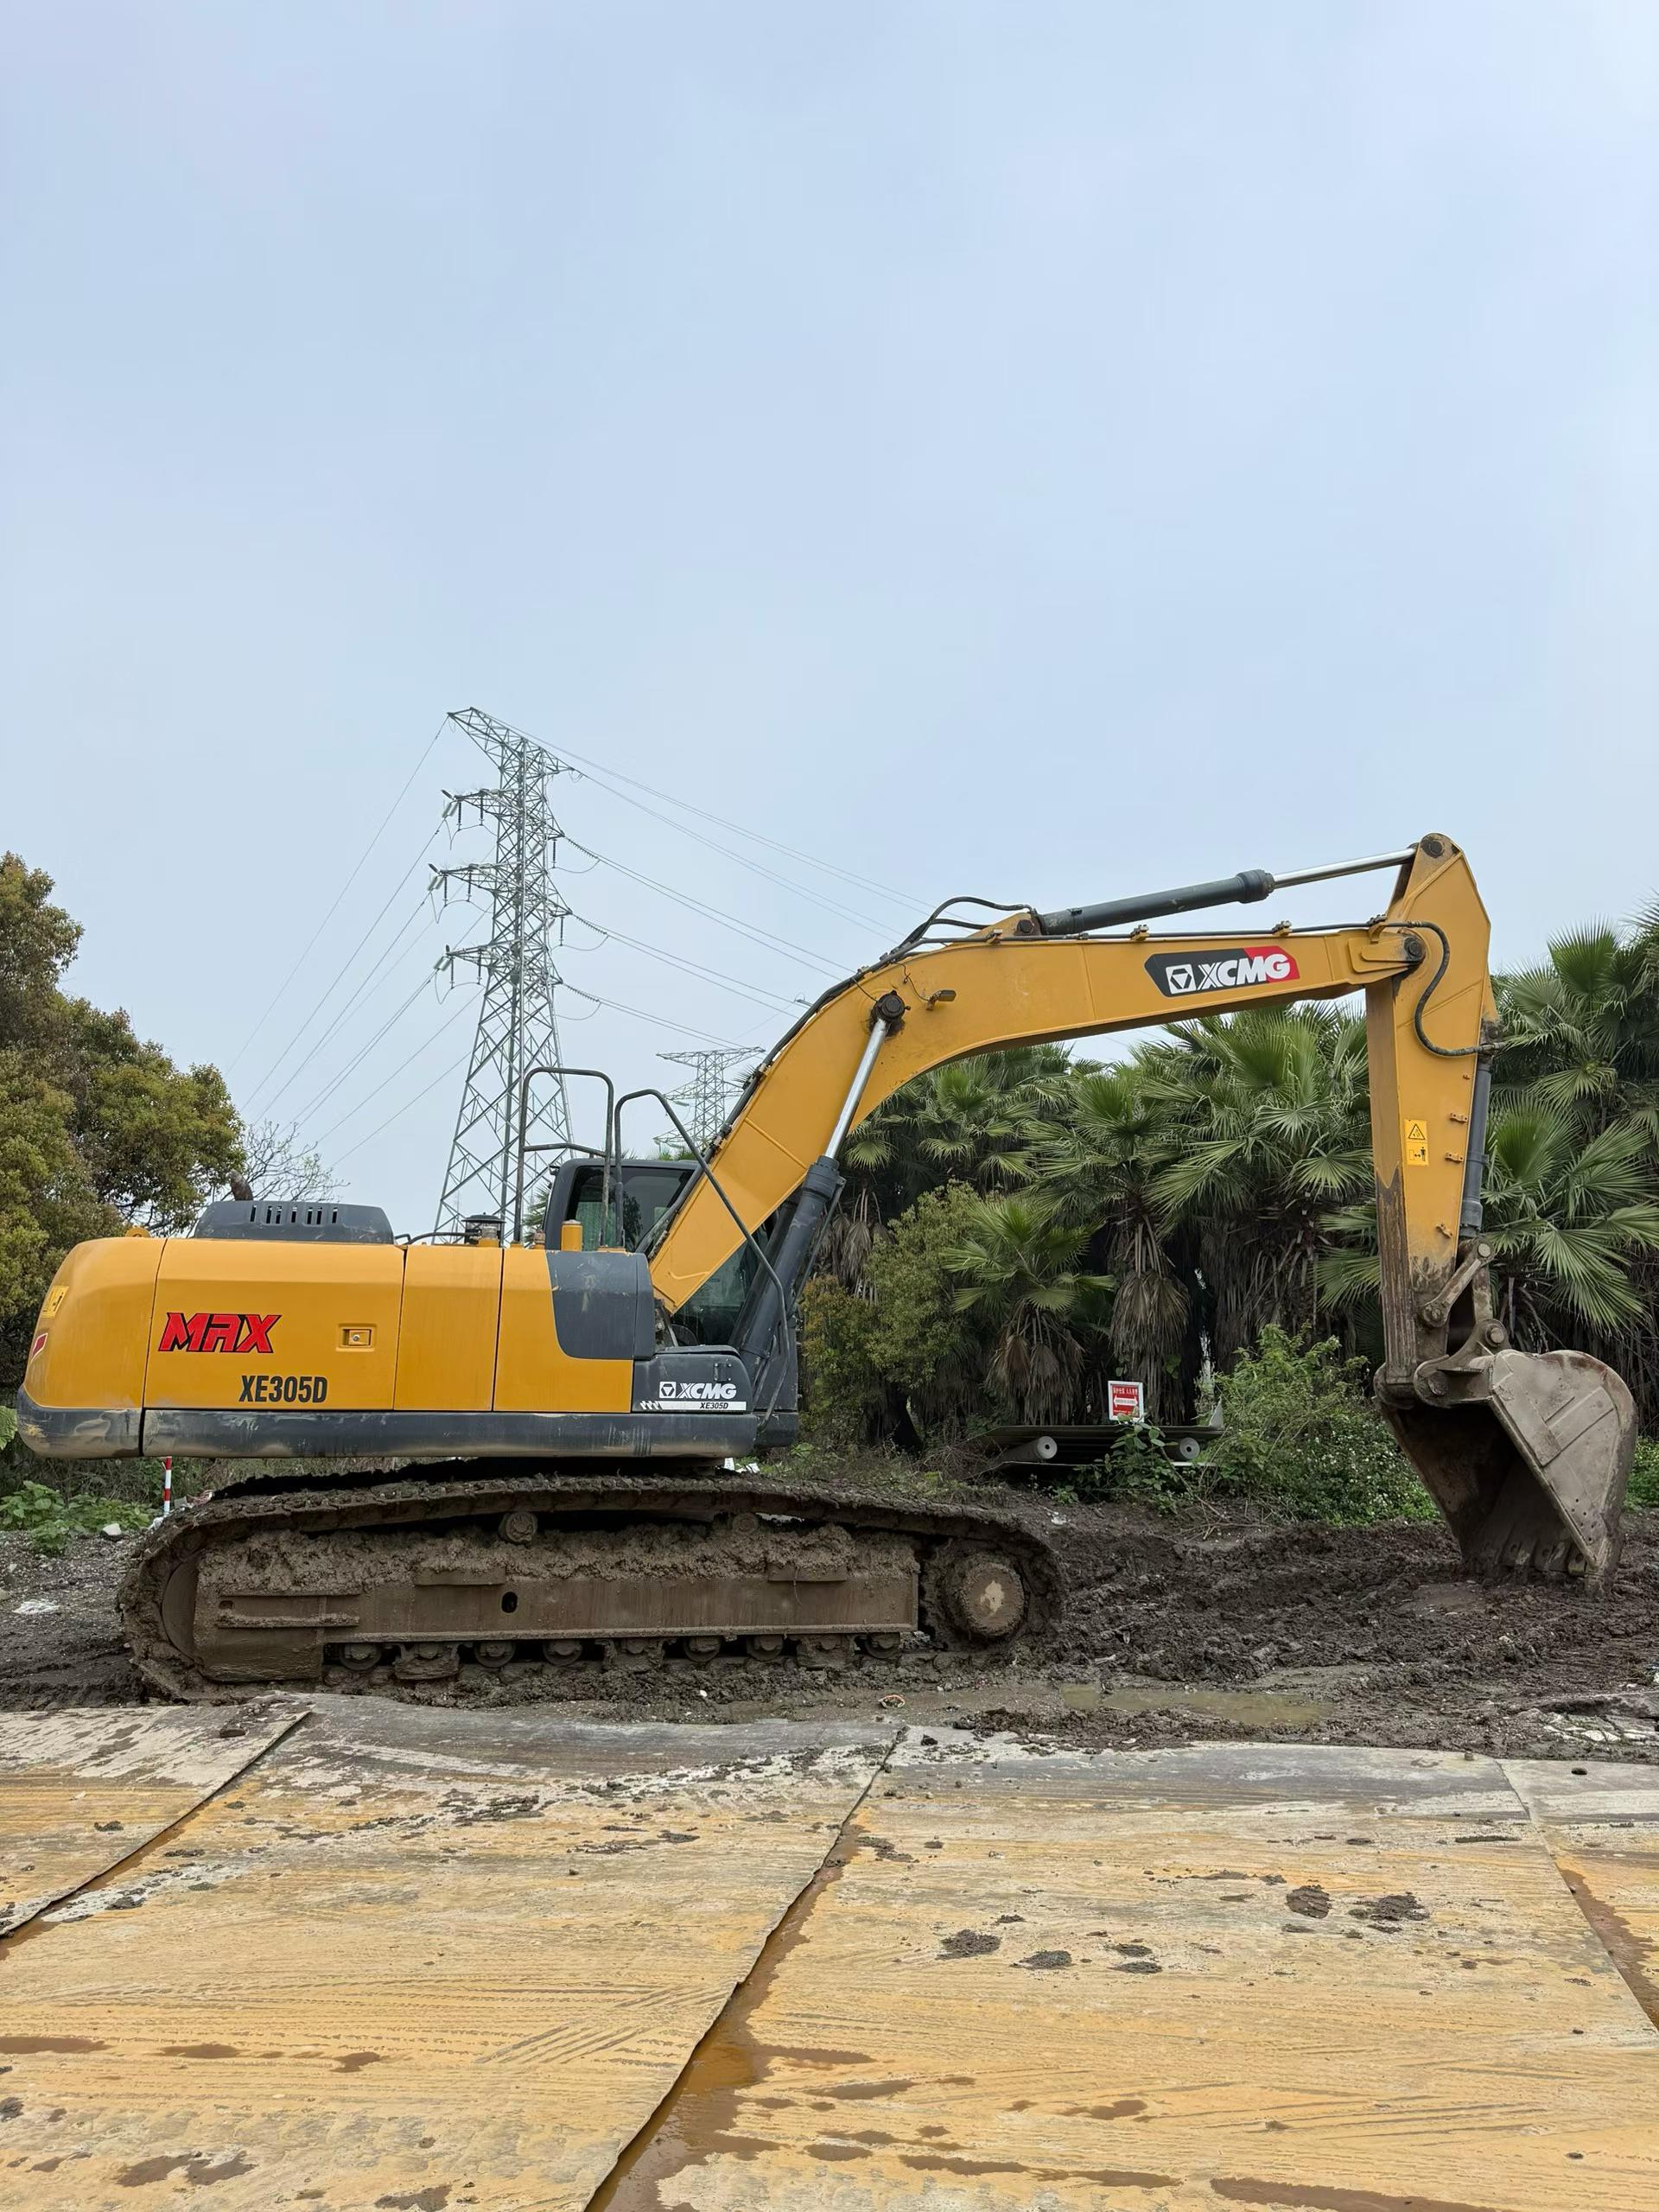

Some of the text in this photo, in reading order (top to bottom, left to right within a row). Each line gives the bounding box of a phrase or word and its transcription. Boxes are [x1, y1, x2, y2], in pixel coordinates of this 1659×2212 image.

[1197, 953, 1291, 990] XCMG
[158, 1313, 283, 1353] MAX
[238, 1375, 328, 1403] XE305D
[676, 1382, 737, 1400] XCMG
